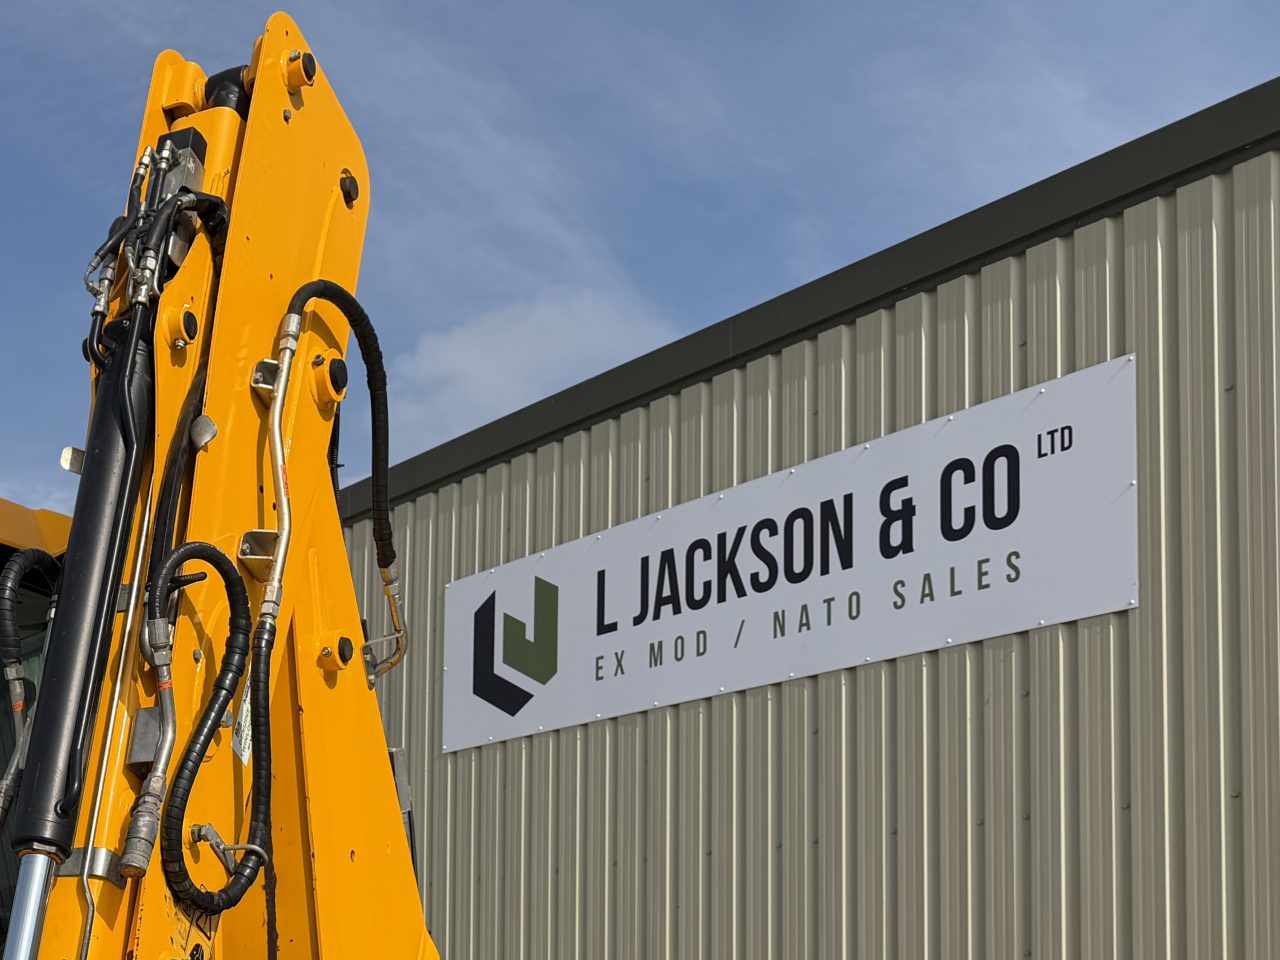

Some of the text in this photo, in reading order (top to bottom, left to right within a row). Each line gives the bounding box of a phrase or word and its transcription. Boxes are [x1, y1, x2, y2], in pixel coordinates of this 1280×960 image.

[597, 425, 1073, 636] L JACKSON & CO LTD
[595, 551, 1021, 681] EX MOD / NATO SALES
